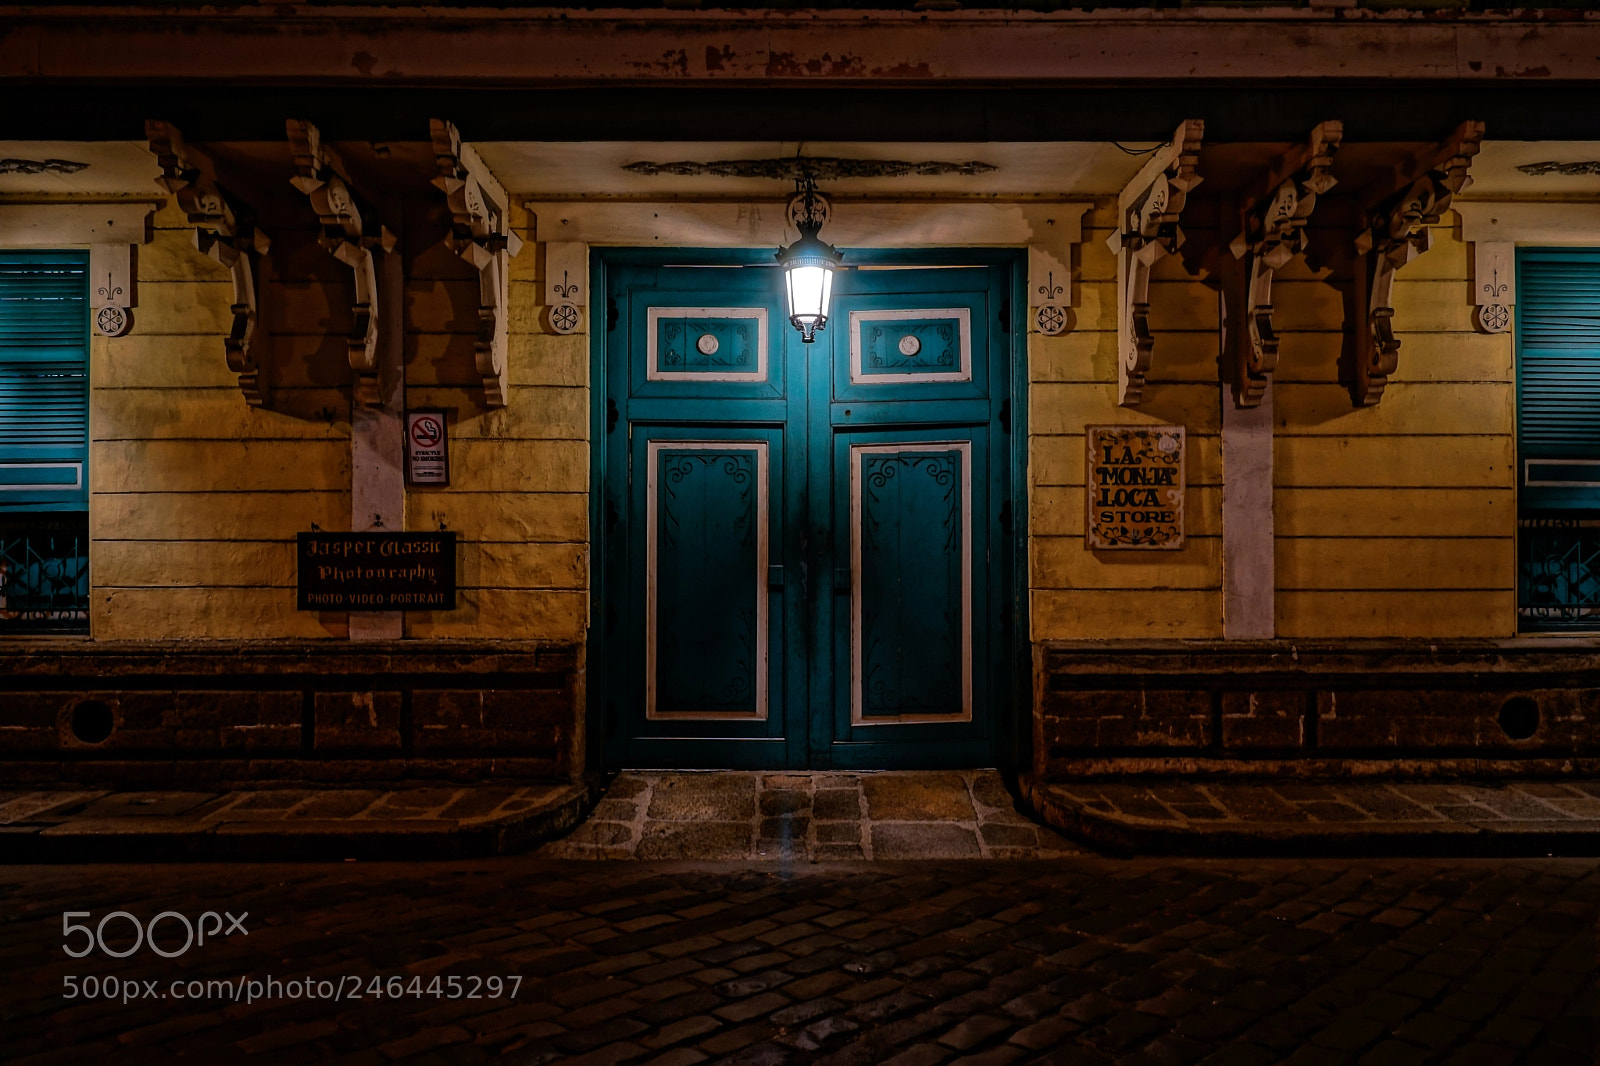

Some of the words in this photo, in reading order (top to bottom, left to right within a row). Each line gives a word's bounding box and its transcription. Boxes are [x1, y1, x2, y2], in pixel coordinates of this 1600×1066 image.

[1102, 445, 1142, 465] LA
[1096, 467, 1177, 486] MONJA
[1096, 488, 1166, 507] LOCA
[1100, 511, 1175, 523] STORE
[306, 539, 377, 558] Jasper
[317, 562, 437, 584] Photography
[389, 593, 445, 605] PORTRAIT
